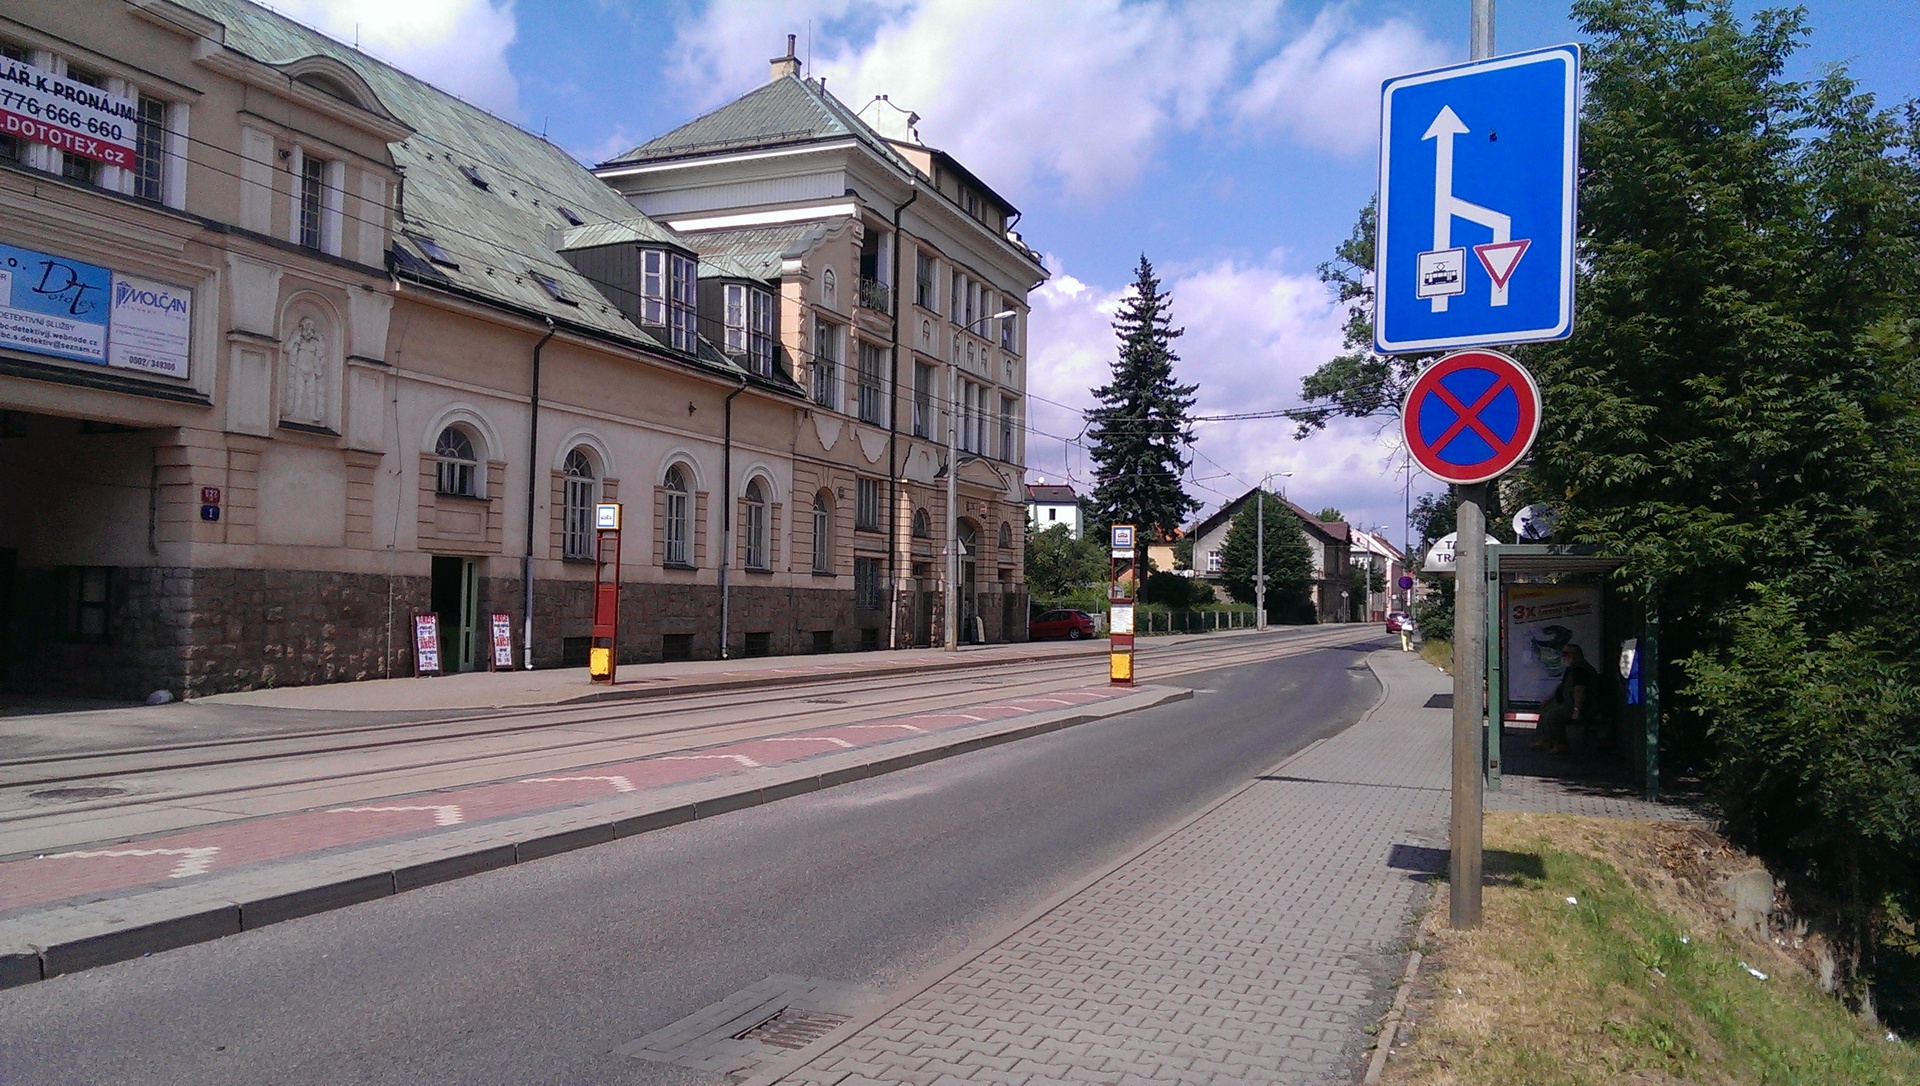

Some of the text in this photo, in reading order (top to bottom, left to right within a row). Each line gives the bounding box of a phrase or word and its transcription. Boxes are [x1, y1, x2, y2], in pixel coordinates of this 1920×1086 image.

[36, 75, 48, 93] K
[1, 88, 122, 140] 776 666 660
[45, 320, 76, 332] SLUŽBY
[208, 507, 214, 518] 1
